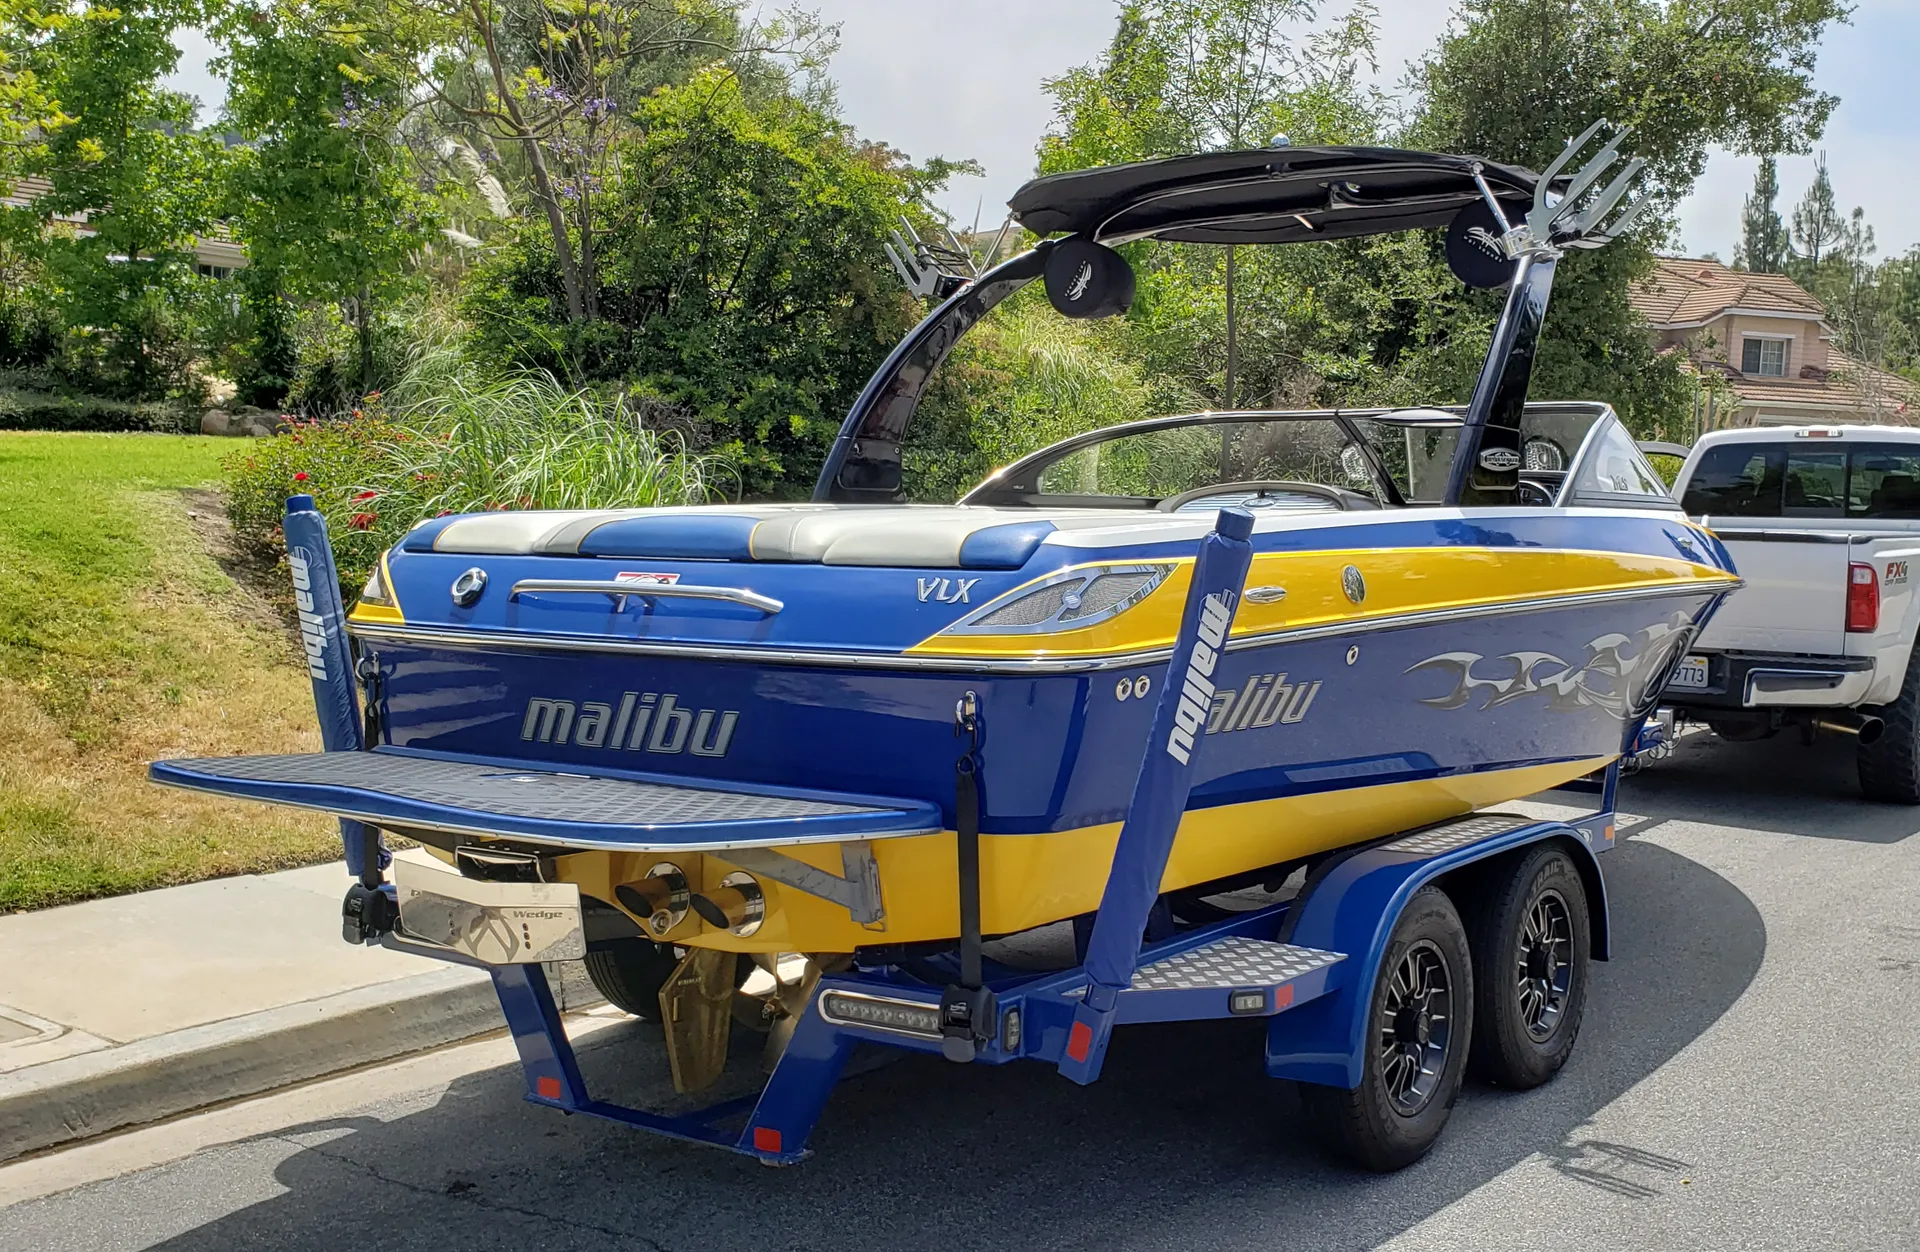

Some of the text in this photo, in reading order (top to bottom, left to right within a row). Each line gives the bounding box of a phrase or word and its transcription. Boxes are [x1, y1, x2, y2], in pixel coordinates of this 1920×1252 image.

[917, 577, 982, 604] VLX
[1885, 561, 1908, 579] FX4
[289, 556, 328, 681] malibu
[1167, 595, 1231, 766] malibu
[1674, 667, 1704, 682] 9773
[520, 691, 740, 758] malibu
[1205, 672, 1323, 735] alibu
[512, 910, 564, 920] Wedge
